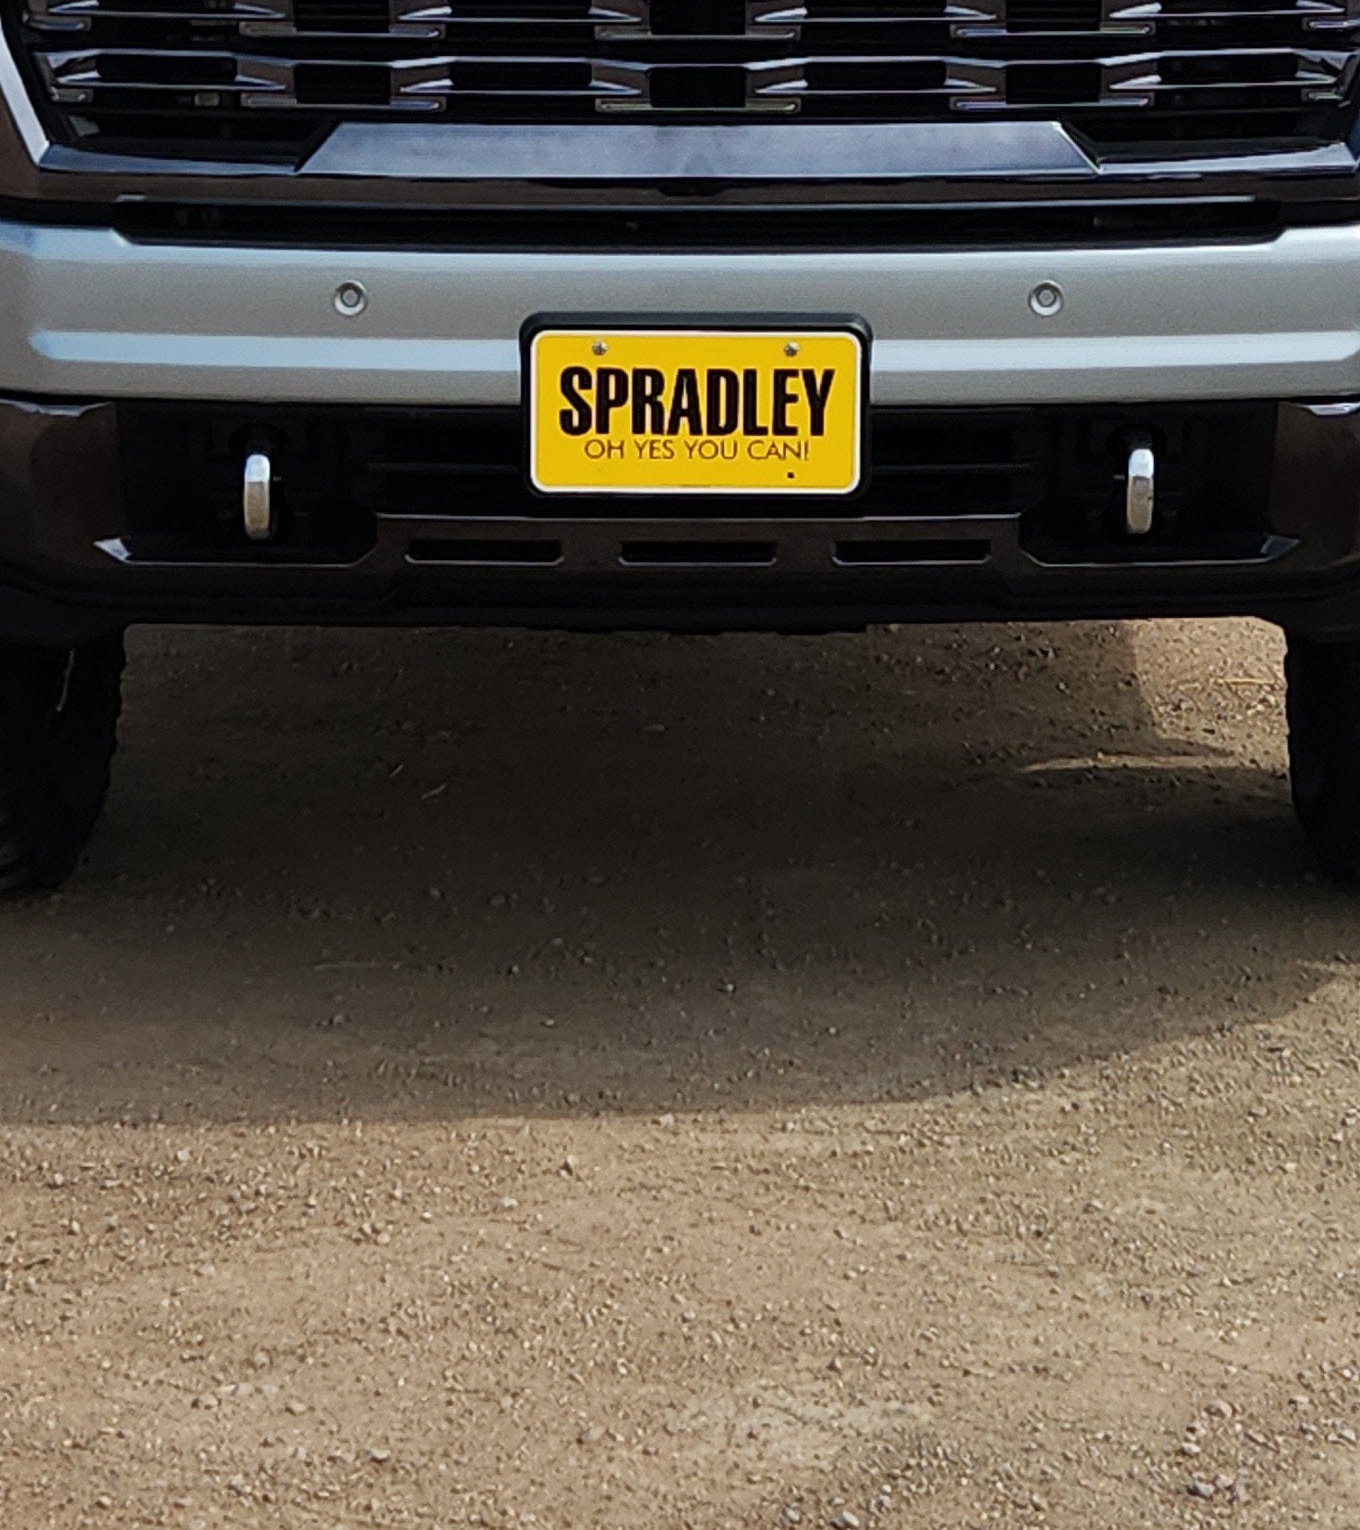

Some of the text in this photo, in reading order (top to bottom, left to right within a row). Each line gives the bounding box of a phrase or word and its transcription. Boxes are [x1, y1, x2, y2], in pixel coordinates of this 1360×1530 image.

[559, 366, 836, 437] SPRADLEY
[584, 439, 809, 462] OH YES YOU CAN!
